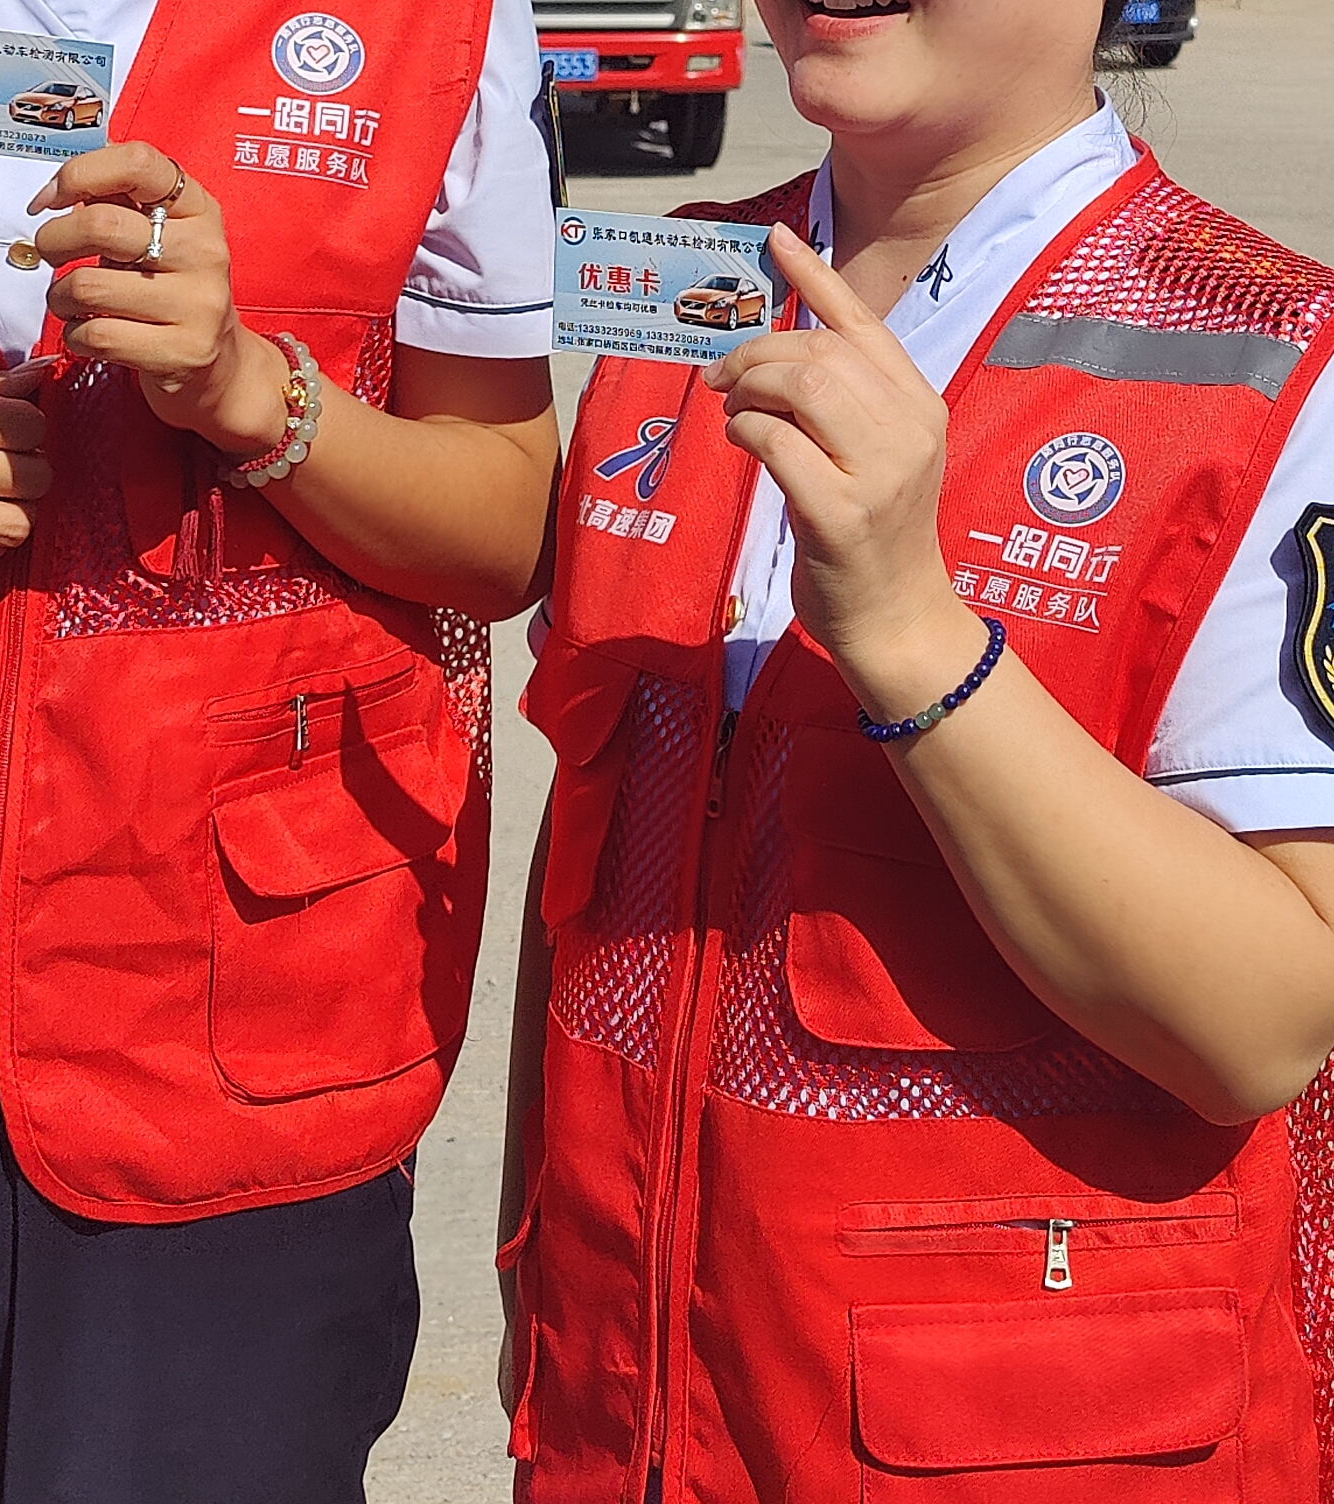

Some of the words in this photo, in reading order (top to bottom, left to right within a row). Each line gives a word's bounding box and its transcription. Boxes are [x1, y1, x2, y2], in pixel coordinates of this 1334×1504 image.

[237, 96, 381, 146] 一路同行
[234, 140, 369, 183] 志愿服务队
[592, 226, 766, 256] 张家口凯通机动车检测有限公司
[578, 263, 661, 296] 优惠卡
[968, 524, 1122, 583] 一路同行
[951, 569, 1100, 627] 志愿服务队
